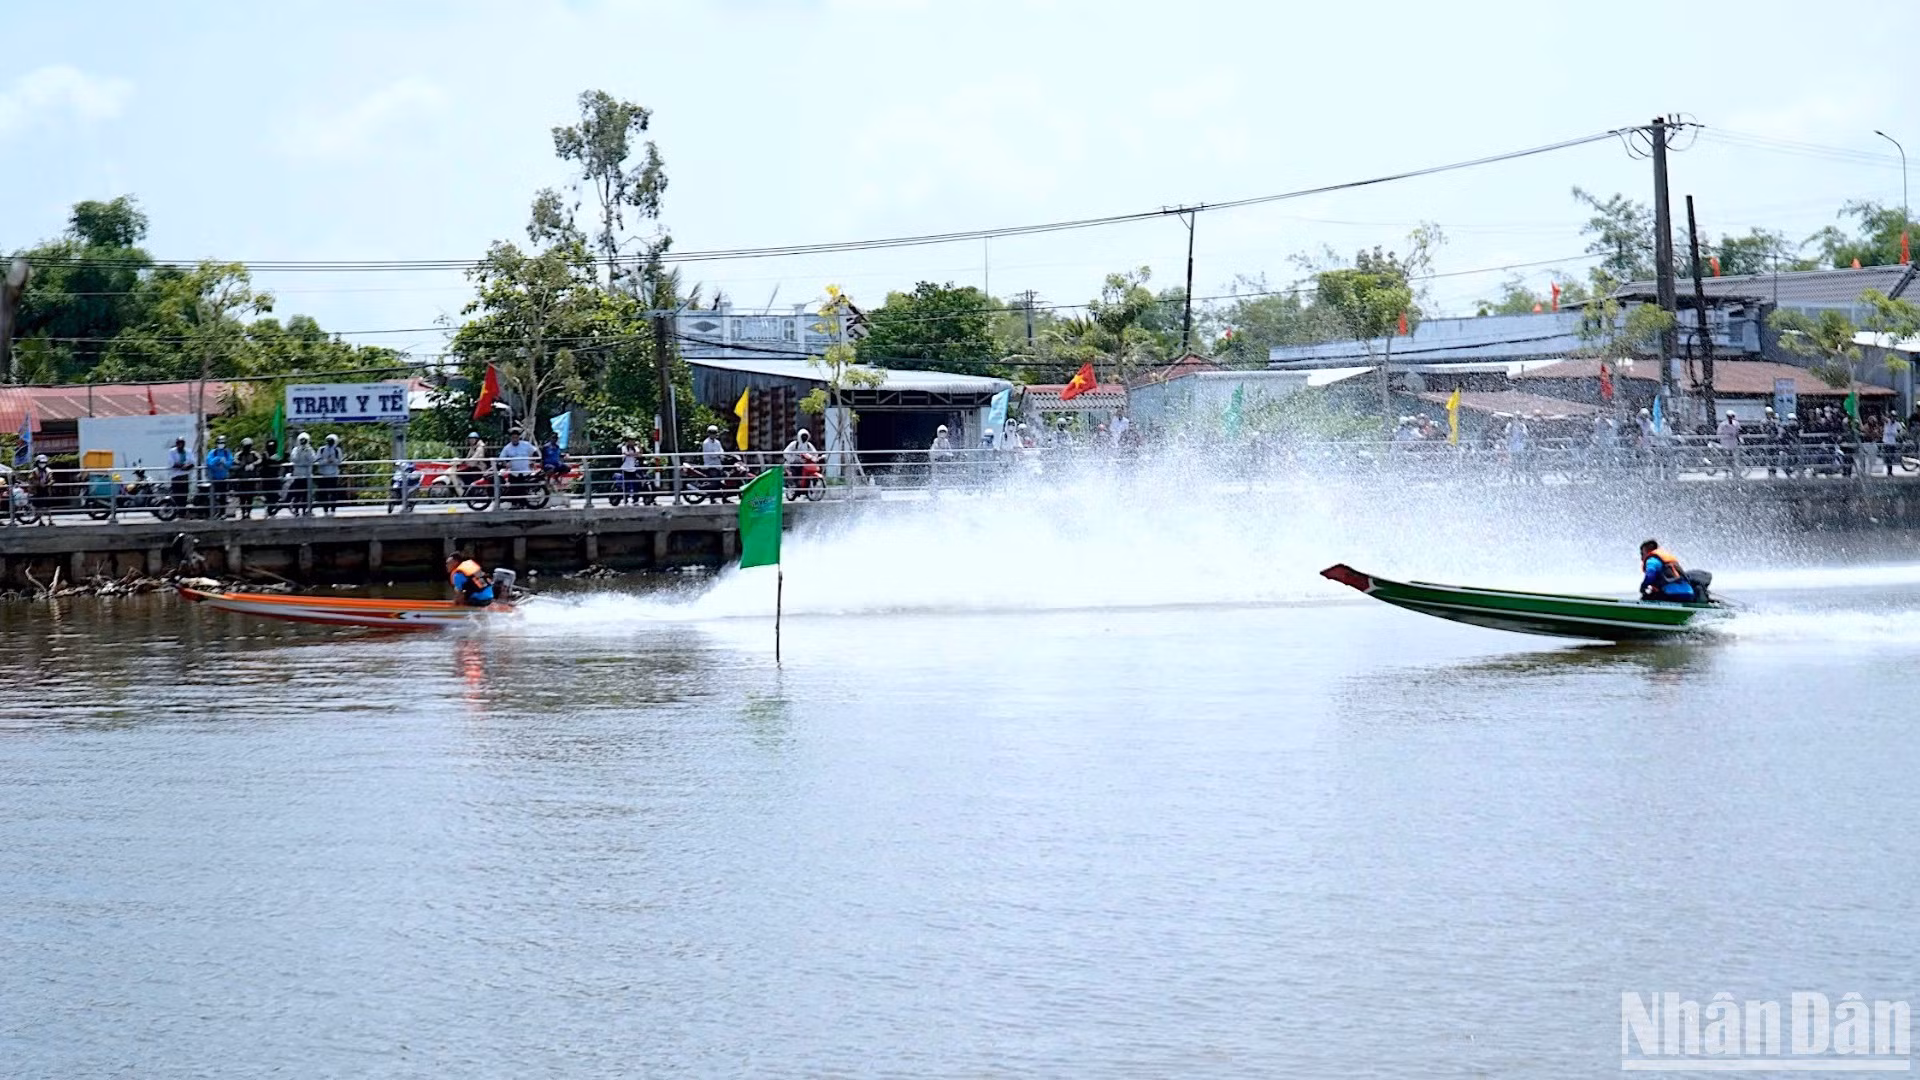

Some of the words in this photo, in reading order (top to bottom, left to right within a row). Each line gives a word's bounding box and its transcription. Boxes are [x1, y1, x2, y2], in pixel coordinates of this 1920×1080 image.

[293, 396, 347, 418] TRẠM
[356, 395, 369, 412] Y
[378, 389, 404, 412] TẾ
